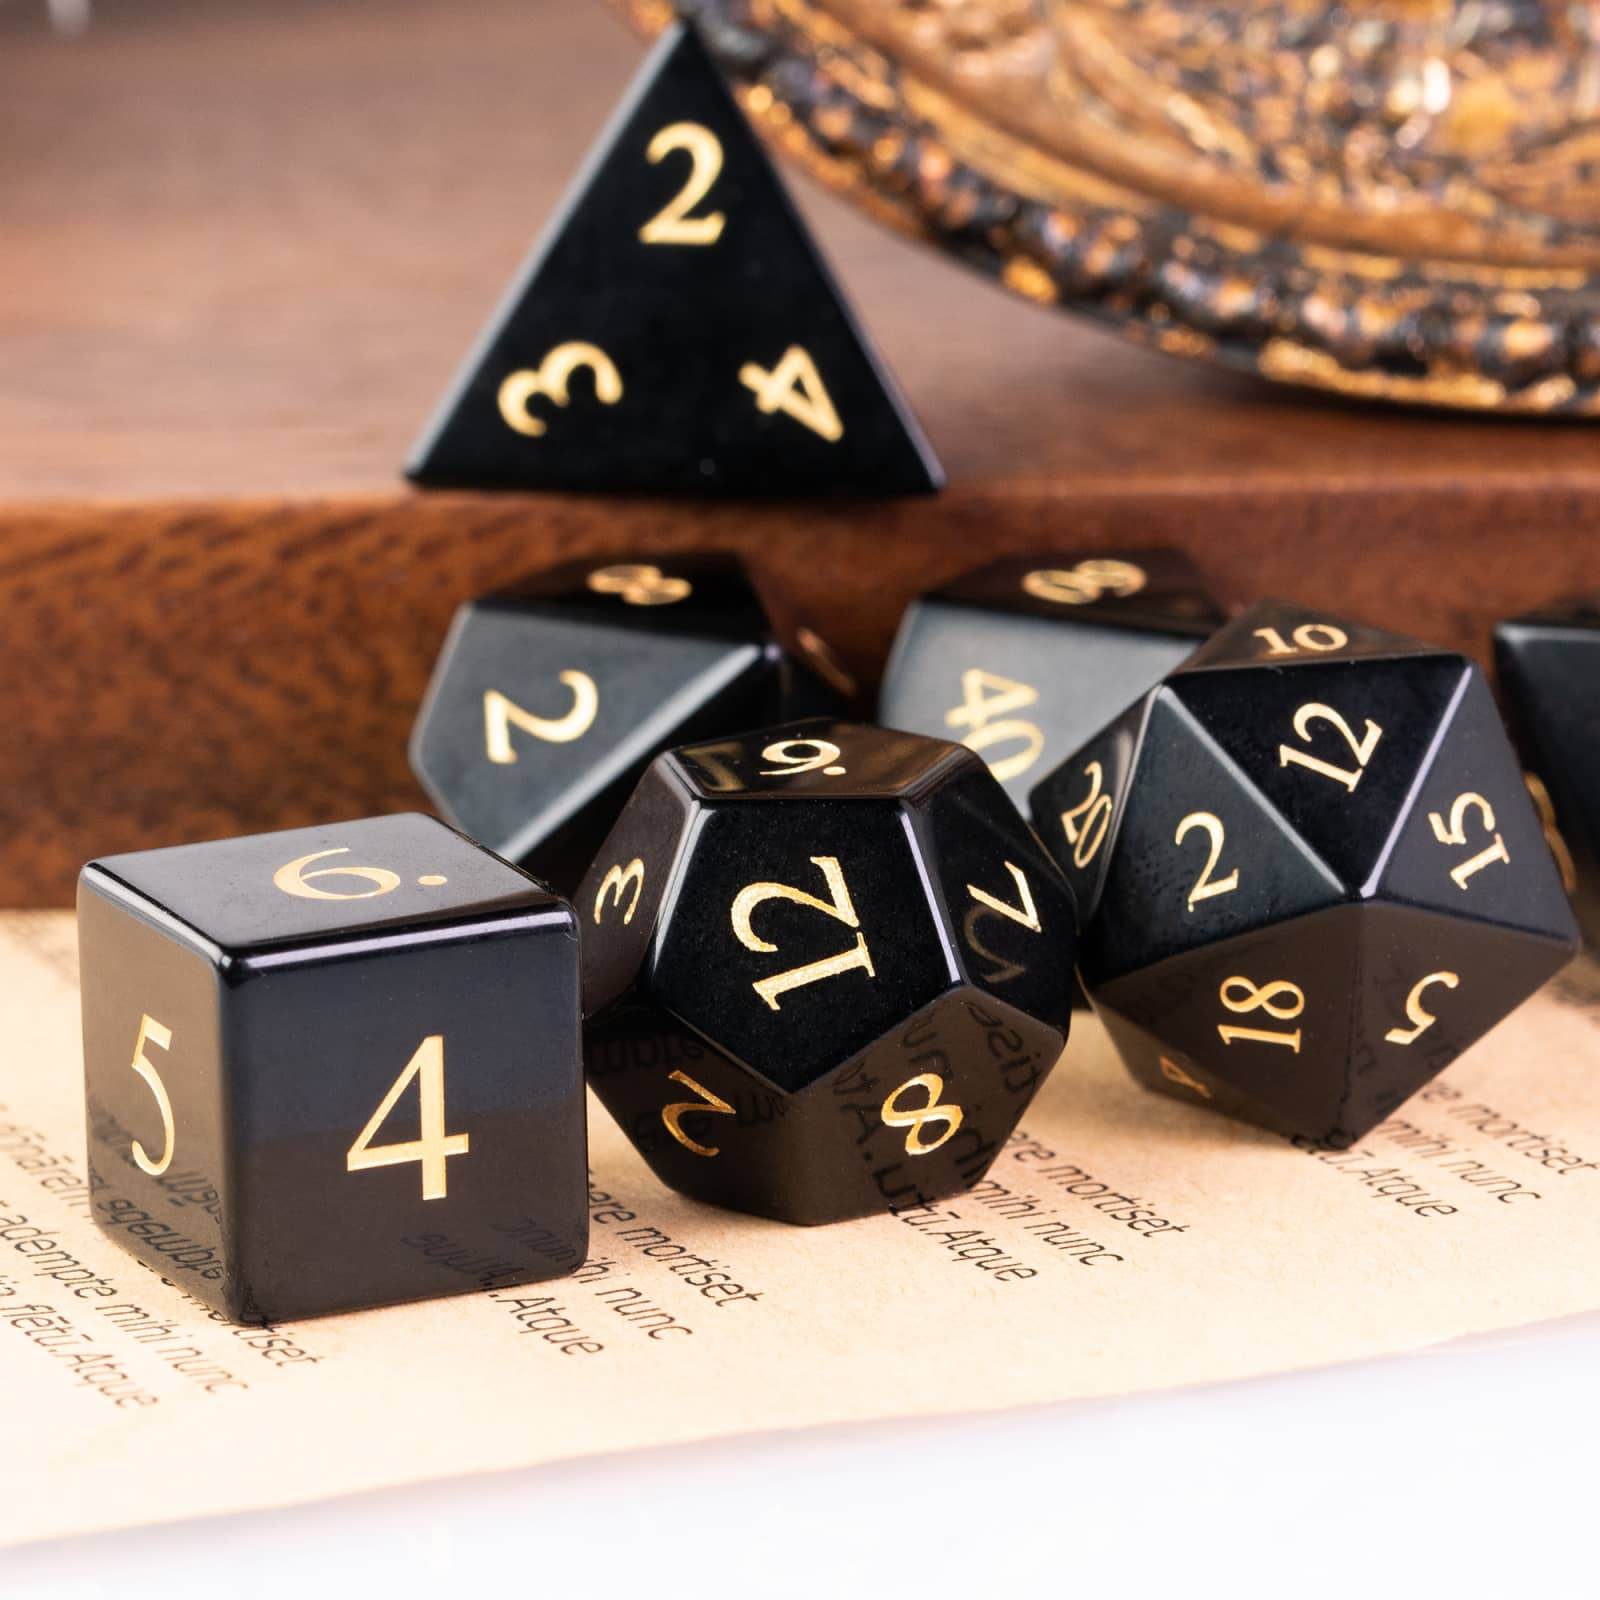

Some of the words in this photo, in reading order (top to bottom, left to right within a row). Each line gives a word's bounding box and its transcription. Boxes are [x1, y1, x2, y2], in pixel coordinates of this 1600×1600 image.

[638, 122, 725, 246] 2
[497, 341, 622, 436] 3
[739, 345, 843, 442] 4
[1253, 624, 1348, 656] 10
[483, 669, 598, 764] 2
[1279, 702, 1383, 793] 12
[1061, 761, 1112, 869] 20
[1429, 791, 1510, 890] 15
[593, 858, 645, 926] 3
[966, 860, 1042, 933] 7
[1175, 811, 1240, 912] 2
[731, 855, 876, 1012] 12
[1217, 975, 1305, 1054] 18
[1385, 970, 1459, 1045] 5
[131, 1014, 175, 1176] 5
[346, 1035, 469, 1200] 4
[661, 1070, 737, 1157] 2
[881, 1073, 963, 1155] 8
[1440, 1158, 1542, 1204] nunc
[1023, 1220, 1124, 1267] nunc
[95, 1303, 190, 1344] mihi
[155, 1343, 250, 1394] nunc
[595, 1286, 693, 1340] nunc
